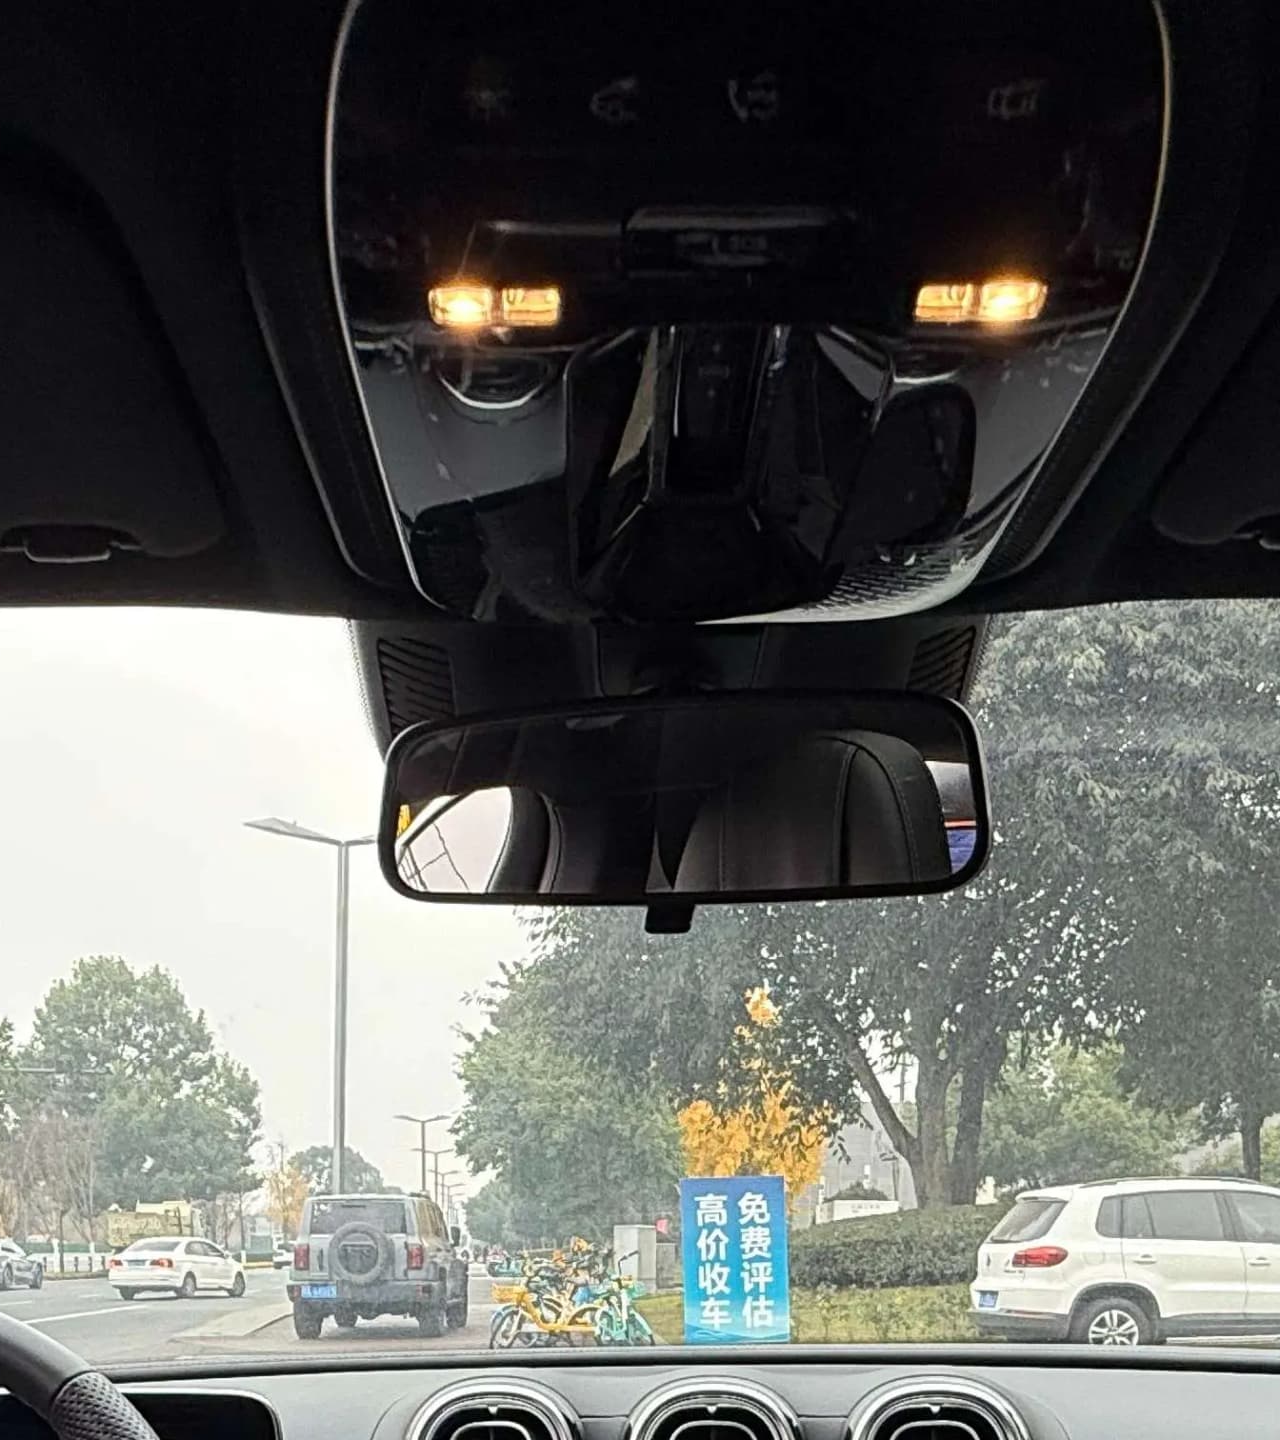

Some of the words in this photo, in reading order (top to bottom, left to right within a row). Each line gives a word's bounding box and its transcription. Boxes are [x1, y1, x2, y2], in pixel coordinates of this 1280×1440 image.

[694, 1193, 732, 1330] 高价收车
[737, 1191, 775, 1329] 免费评估
